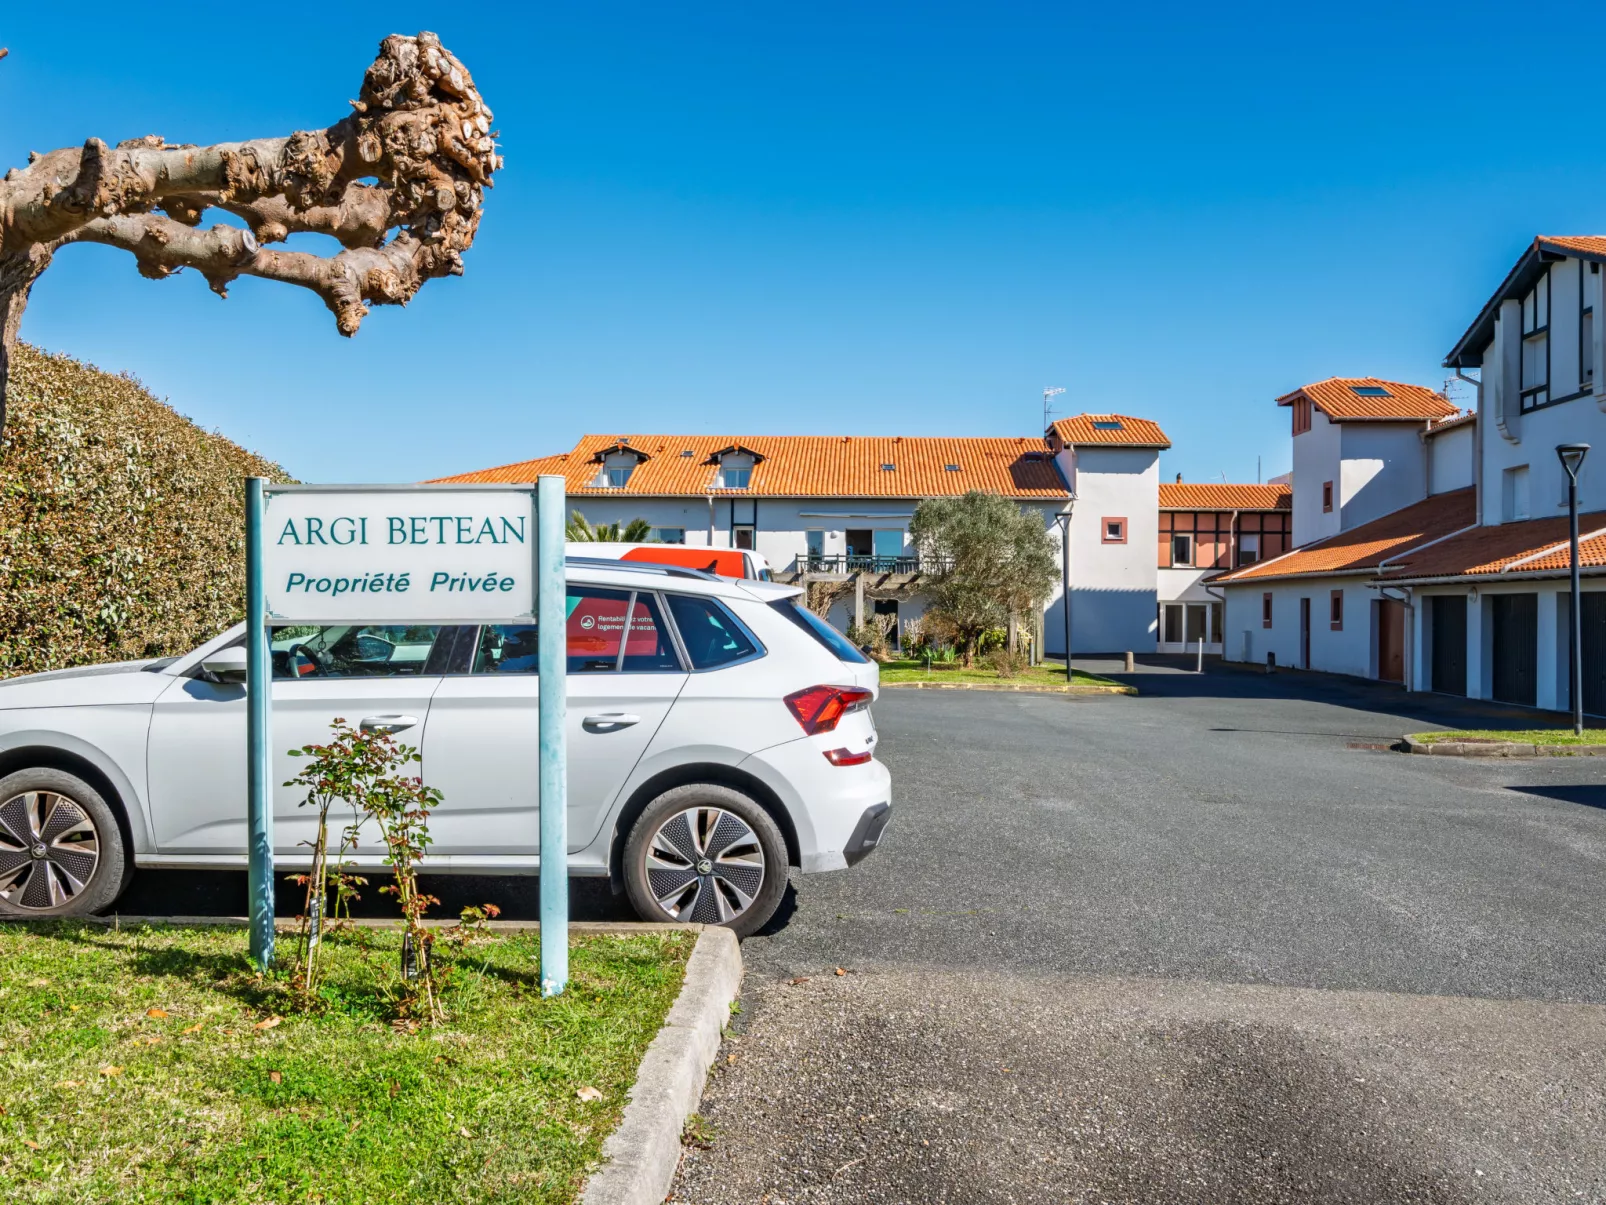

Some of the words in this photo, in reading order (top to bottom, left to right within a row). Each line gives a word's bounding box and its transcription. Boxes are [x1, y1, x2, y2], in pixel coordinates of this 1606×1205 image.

[276, 517, 369, 545] ARGI
[386, 516, 526, 545] BETEAN
[285, 572, 411, 597] Propriété
[429, 571, 515, 593] Privée
[598, 615, 636, 623] Rentabiliz
[597, 624, 624, 632] logemen
